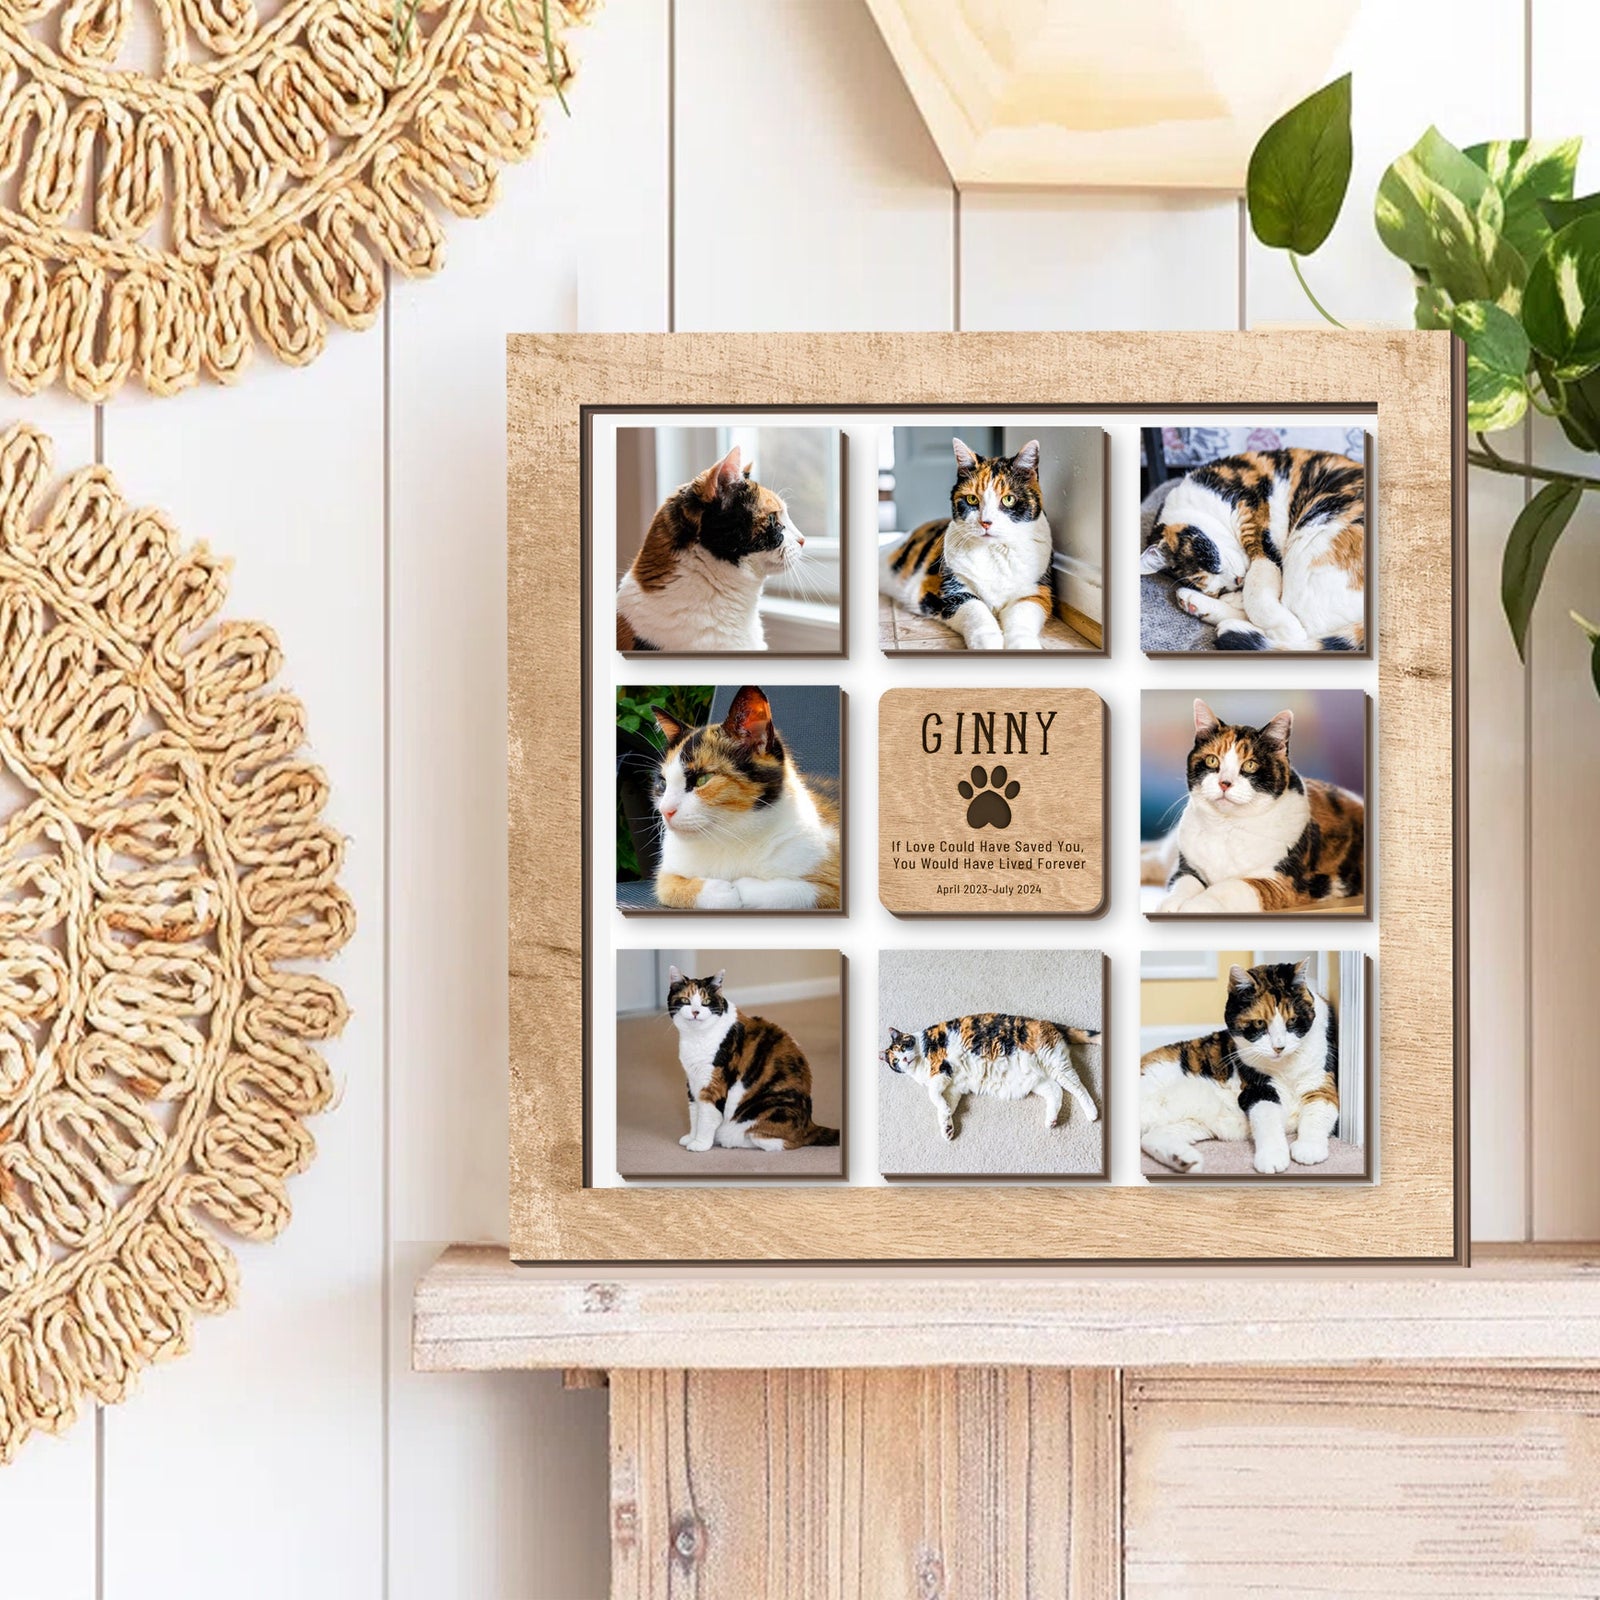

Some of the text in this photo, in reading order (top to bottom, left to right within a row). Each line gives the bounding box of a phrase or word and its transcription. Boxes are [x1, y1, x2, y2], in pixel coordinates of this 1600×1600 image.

[922, 712, 1057, 755] GINNY
[892, 841, 1084, 853] If Love Could Have Saved You,
[893, 858, 1086, 869] You Would Have Lived Forever
[936, 884, 1042, 896] April 2023-July 2024
